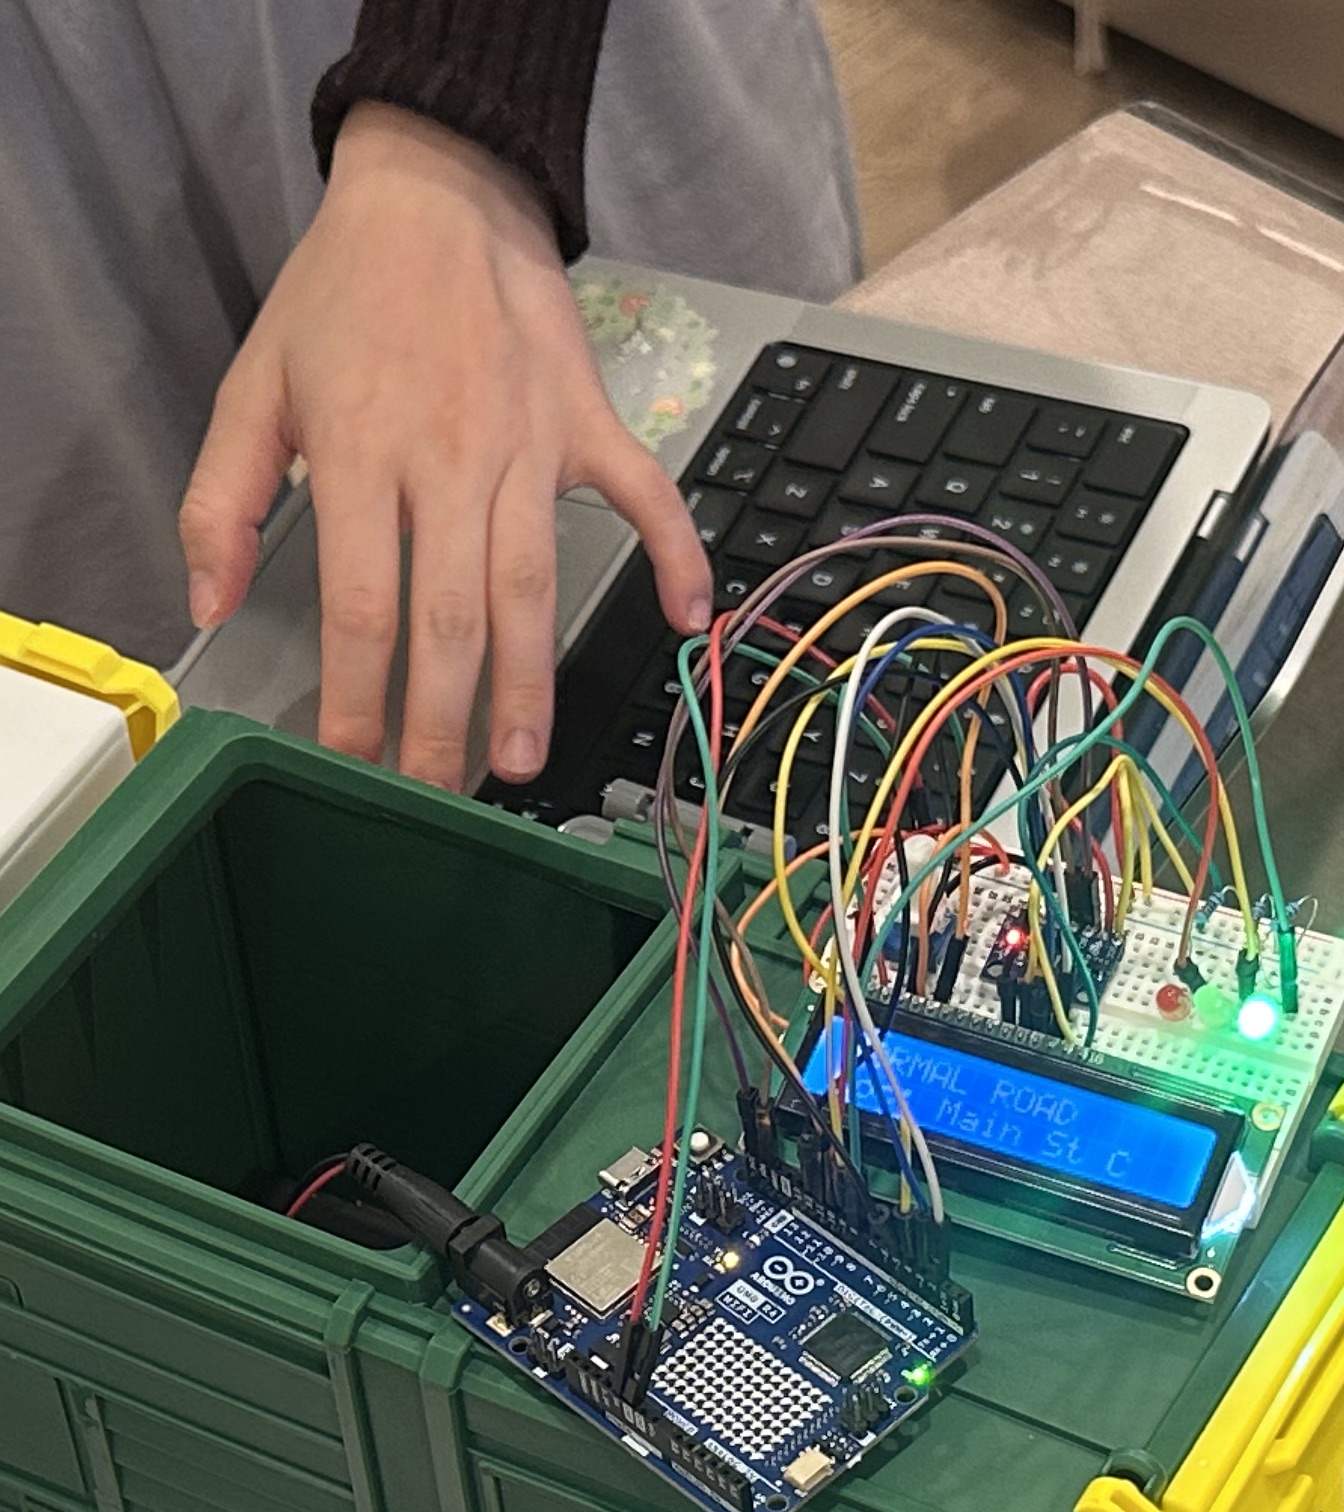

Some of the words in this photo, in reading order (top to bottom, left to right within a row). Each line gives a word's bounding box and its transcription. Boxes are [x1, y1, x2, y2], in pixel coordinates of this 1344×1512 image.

[892, 1046, 966, 1097] RMAL
[992, 1078, 1080, 1129] ROAD
[936, 1096, 1025, 1144] Main
[1040, 1131, 1084, 1167] St
[736, 1286, 759, 1304] UNO
[761, 1304, 778, 1319] R4
[750, 1271, 796, 1306] ARDUINO
[722, 1295, 754, 1320] WIFI
